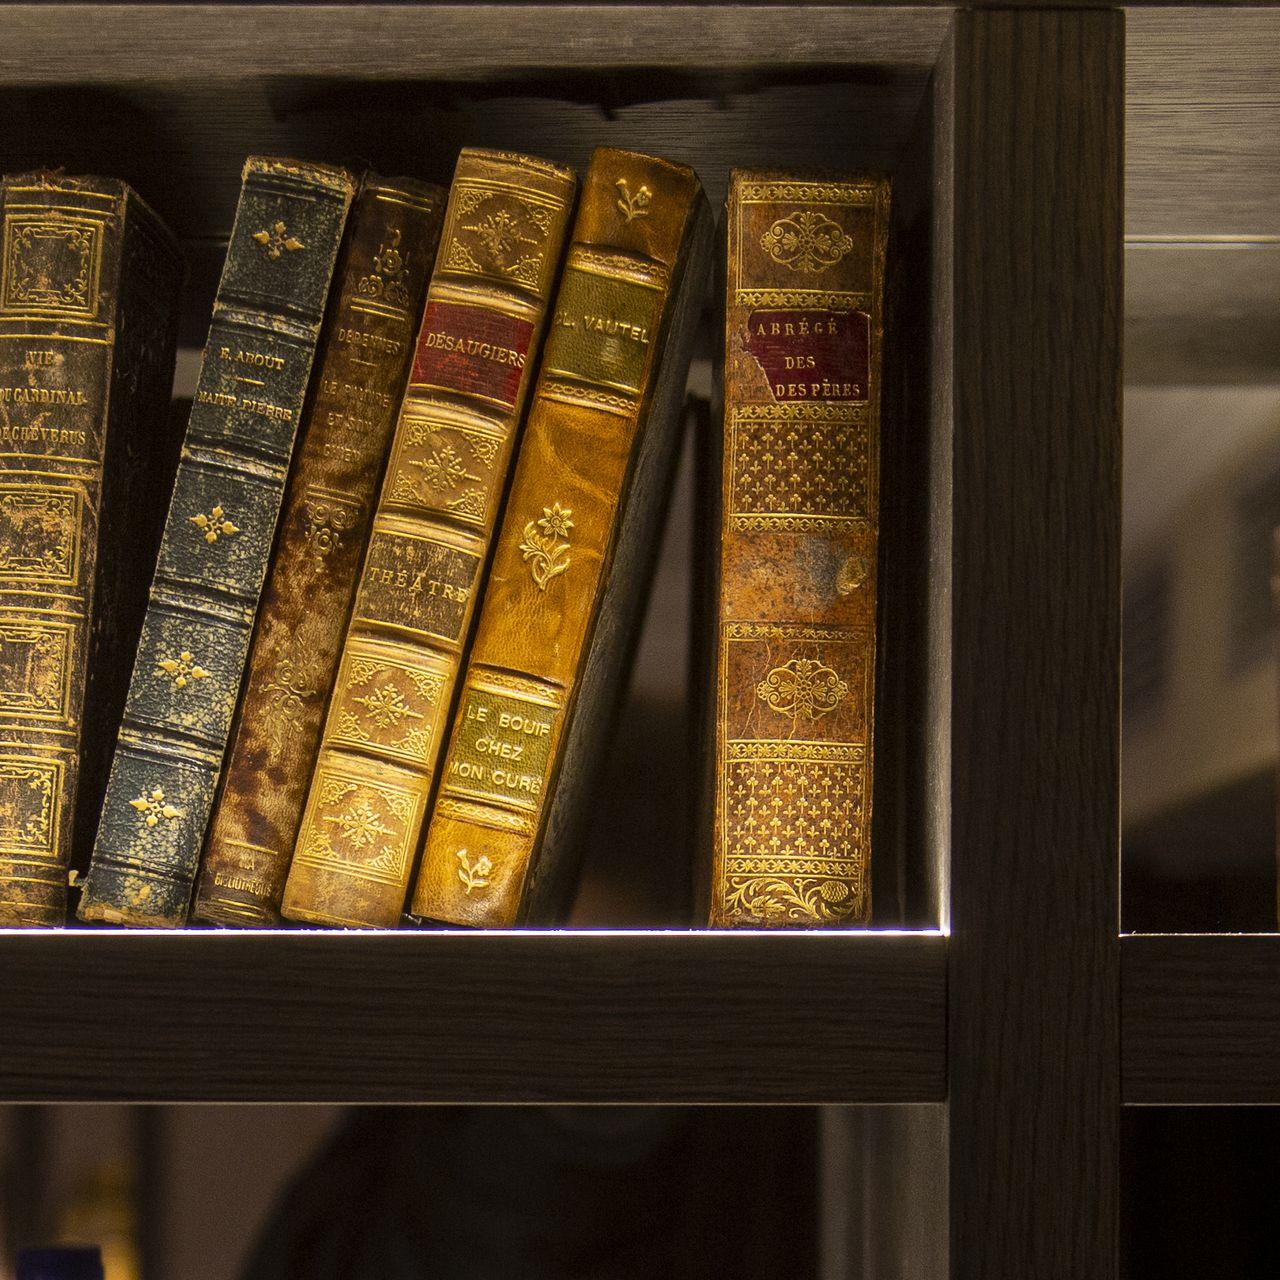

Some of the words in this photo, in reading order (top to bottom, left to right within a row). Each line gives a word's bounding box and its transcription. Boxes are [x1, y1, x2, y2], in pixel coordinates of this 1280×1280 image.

[584, 315, 650, 344] VAUTEL
[756, 317, 838, 336] ABRÉGÉ
[28, 351, 54, 365] VIE
[425, 331, 527, 368] DÉSAUGIERS
[237, 351, 285, 371] ABOUT
[784, 356, 816, 370] DES
[775, 383, 807, 397] DES
[466, 704, 488, 722] LE
[499, 713, 551, 737] BOUIF
[475, 738, 524, 762] CHEZ
